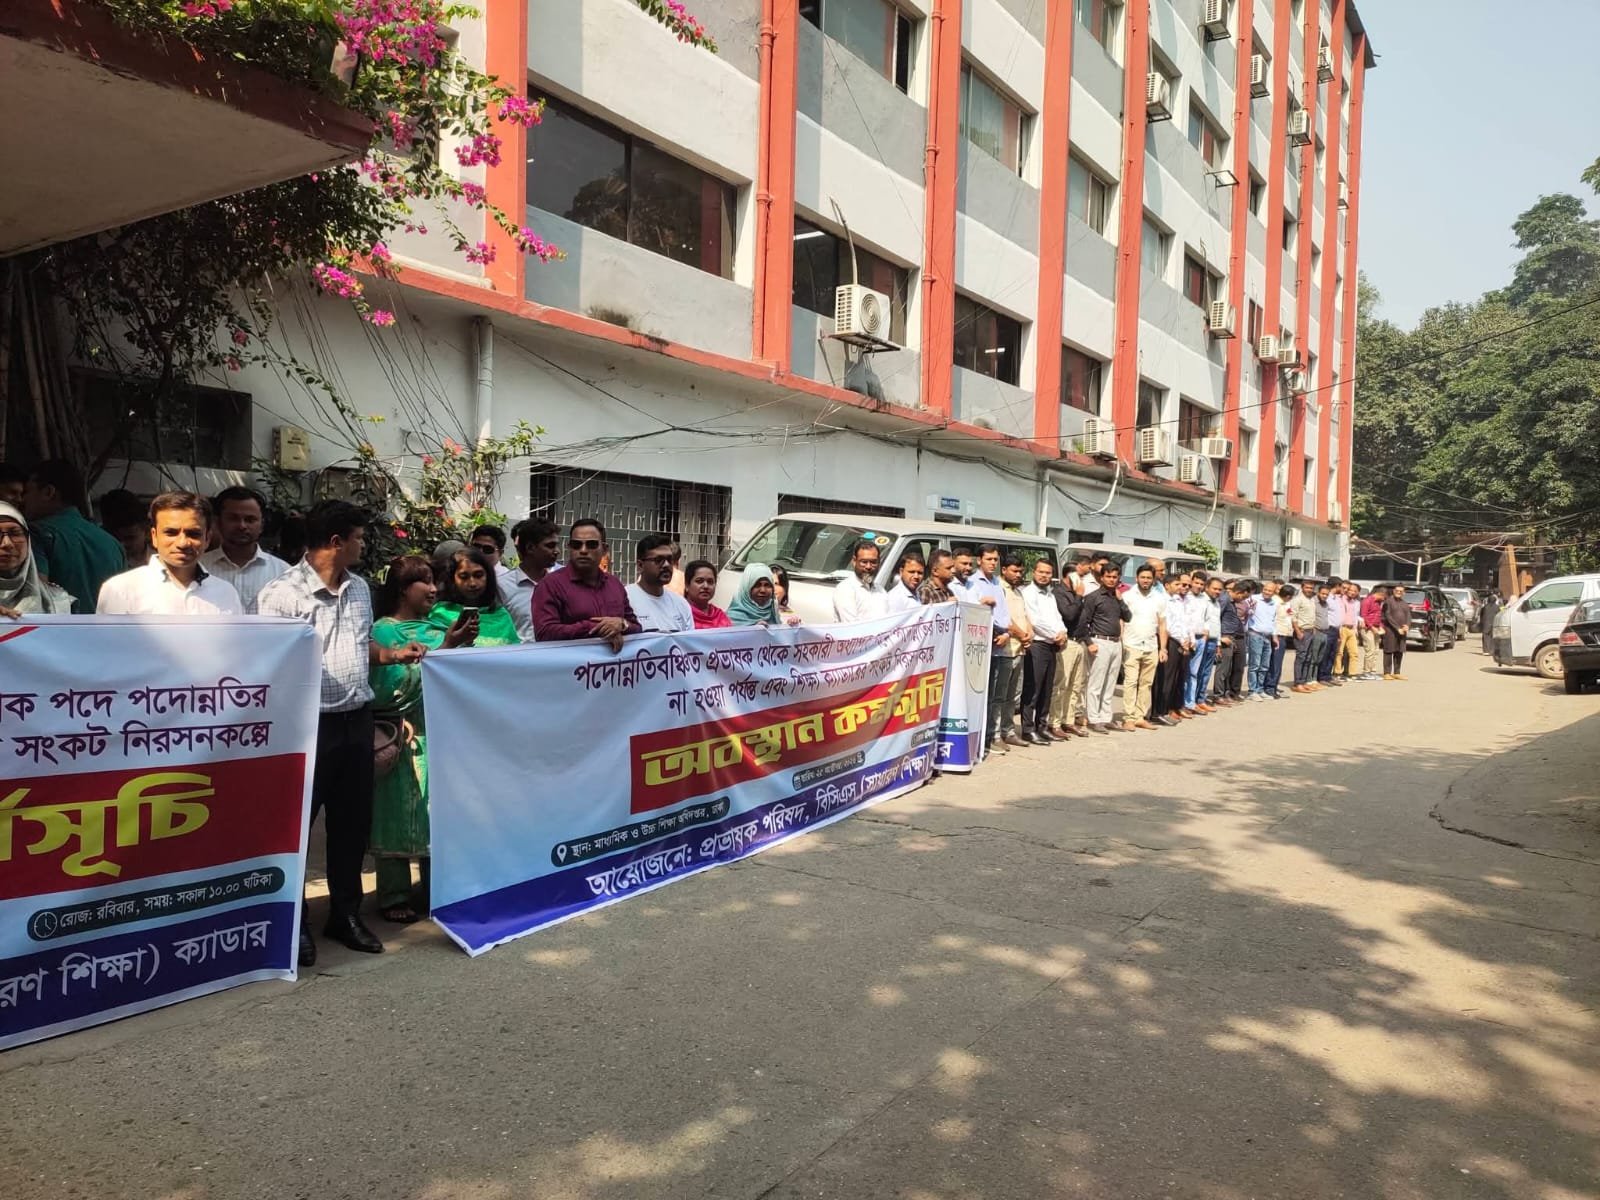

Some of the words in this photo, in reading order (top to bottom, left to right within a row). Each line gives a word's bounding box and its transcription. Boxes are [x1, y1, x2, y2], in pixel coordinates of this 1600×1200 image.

[573, 645, 704, 690] পদোন্নতিবঞ্চিত
[706, 647, 754, 673] প্রভাষক
[757, 643, 791, 666] থেকে
[794, 633, 835, 663] সহকারী
[50, 688, 117, 718] পদে
[128, 676, 271, 717] পদোন্নতির
[666, 688, 689, 716] না
[693, 684, 726, 712] হওয়া
[728, 673, 760, 705] পর্যন্ত
[760, 678, 788, 698] এবং
[790, 667, 820, 694] শিক্ষা
[12, 722, 112, 765] সংকট
[120, 720, 272, 757] নিরসনকল্পে
[641, 713, 825, 787] অবস্থান
[830, 672, 944, 736] কর্মসূচি
[585, 843, 693, 896] আয়োজনে:
[700, 818, 760, 858] প্রভাষক
[762, 802, 809, 834] পরিষদ,
[815, 784, 857, 816] বিসিএস
[594, 831, 629, 849] মাধ্যমিক
[631, 829, 639, 838] ও
[60, 909, 93, 928] রোজ:
[144, 894, 173, 911] সময়:
[176, 887, 208, 905] সকাল
[208, 882, 240, 899] ১০.০০
[243, 871, 273, 889] ঘটিকা
[58, 943, 160, 996] শিক্ষা)
[172, 920, 272, 966] ক্যাডার
